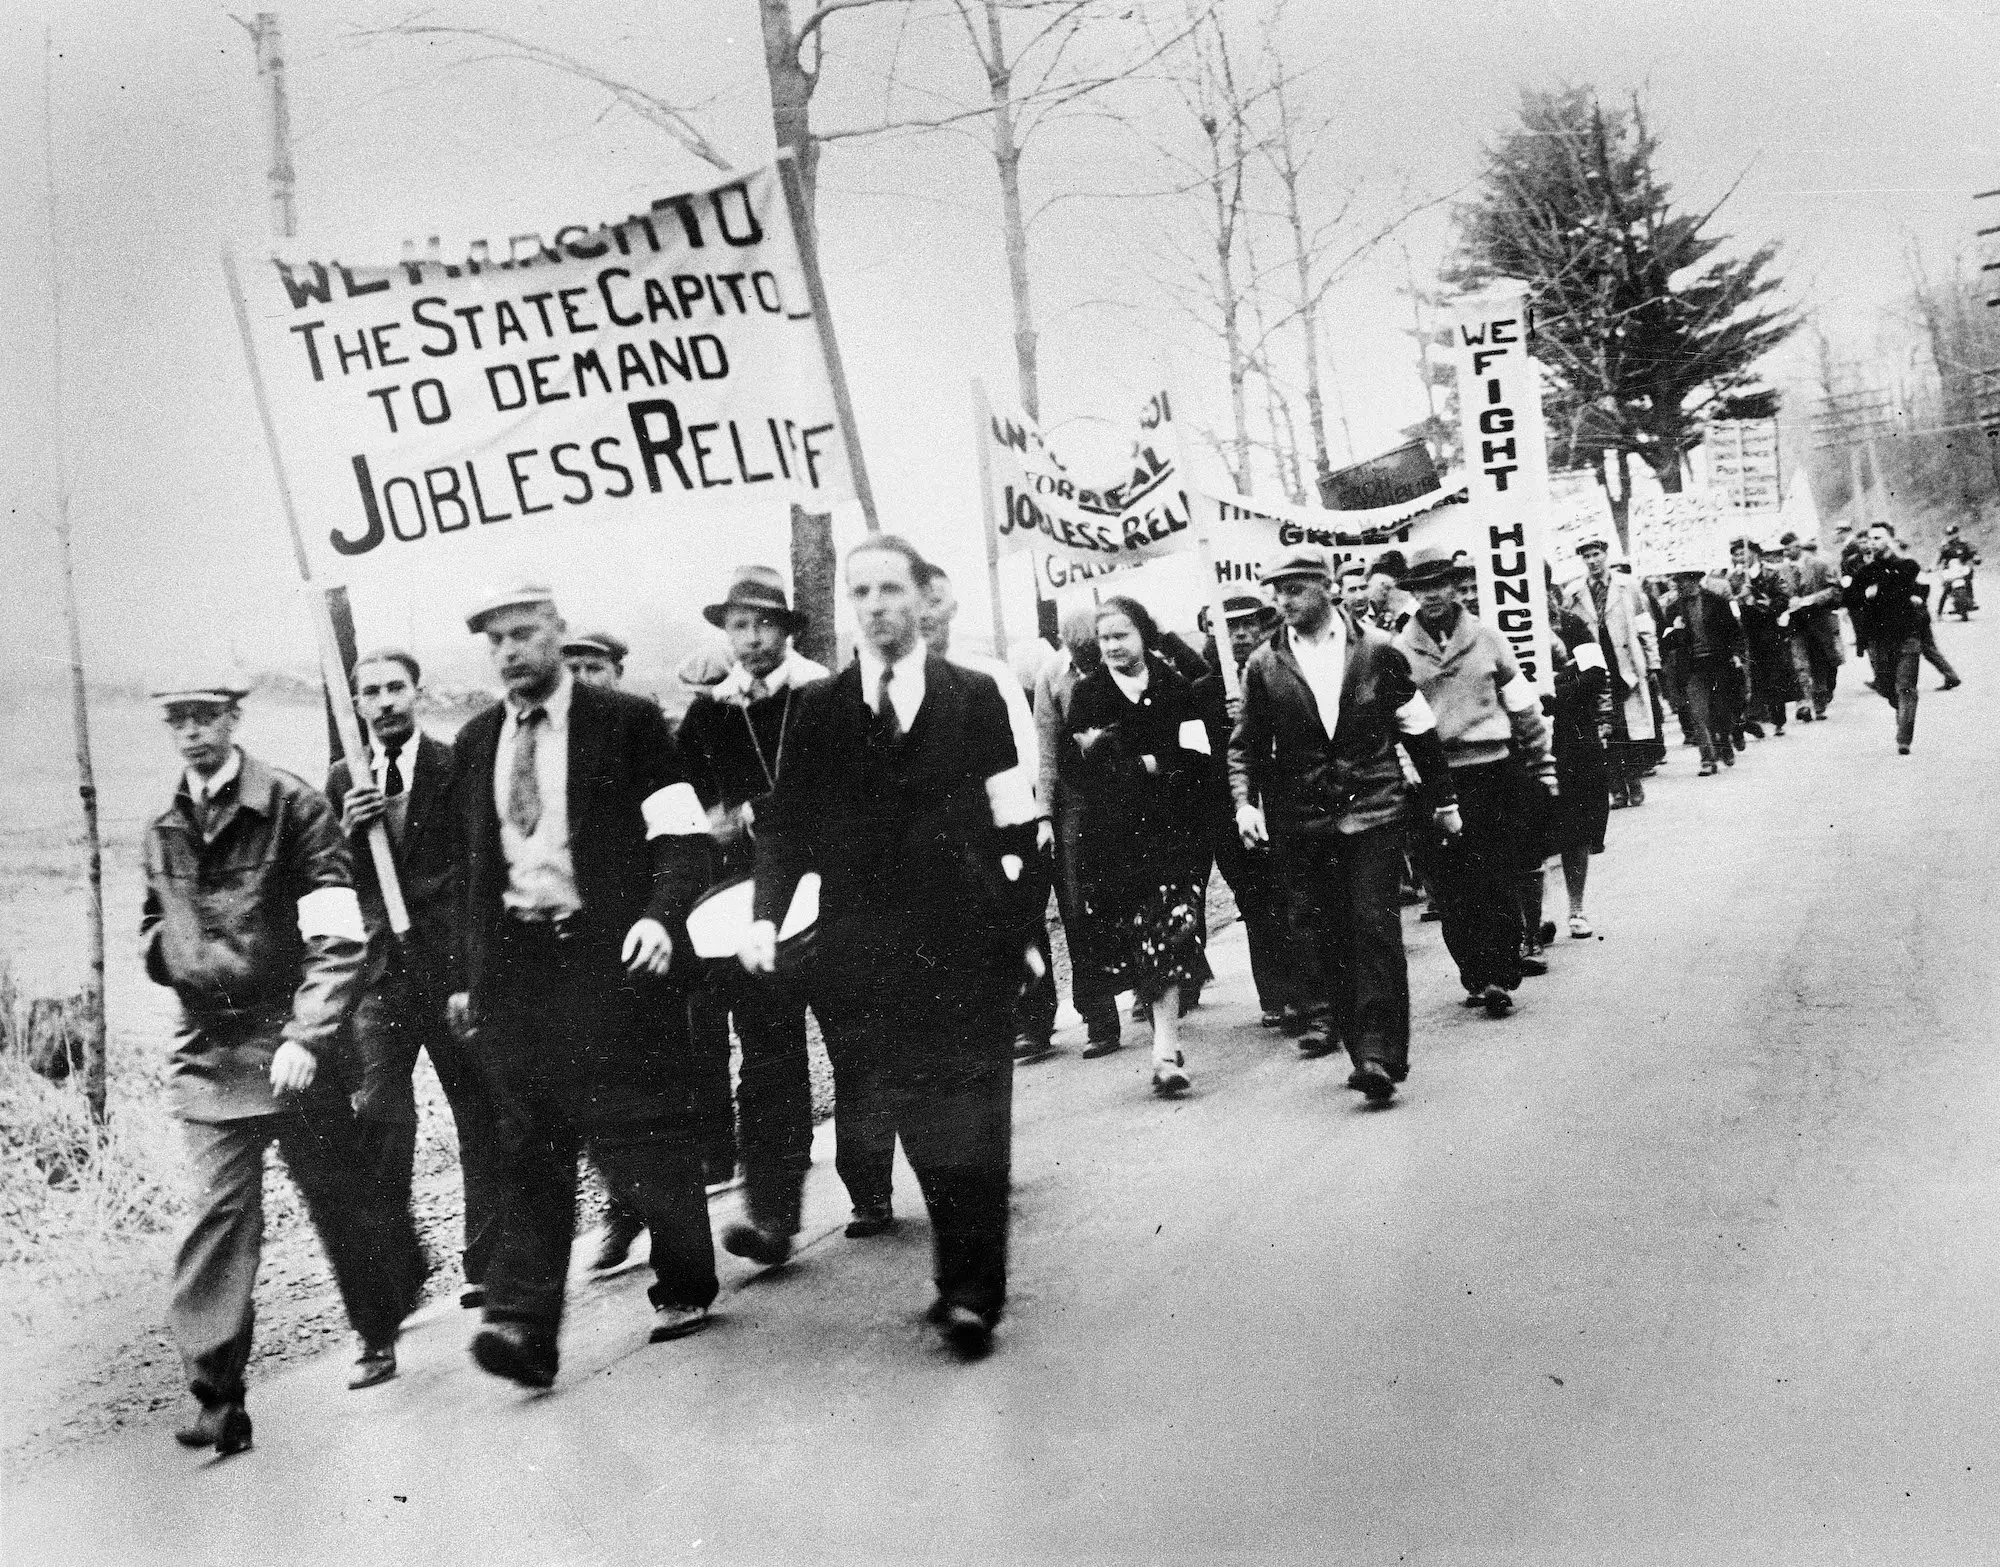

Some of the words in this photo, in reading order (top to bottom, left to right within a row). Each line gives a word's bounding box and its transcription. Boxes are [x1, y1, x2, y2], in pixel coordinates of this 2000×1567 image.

[651, 181, 764, 249] TO
[290, 320, 409, 382] THE
[412, 287, 597, 357] STATE
[597, 267, 812, 328] CAPITO
[1461, 319, 1518, 346] WE
[368, 378, 452, 433] TO
[485, 333, 730, 412] DEMAND
[1474, 349, 1518, 491] FIGHT
[329, 436, 635, 556] JOBLESS
